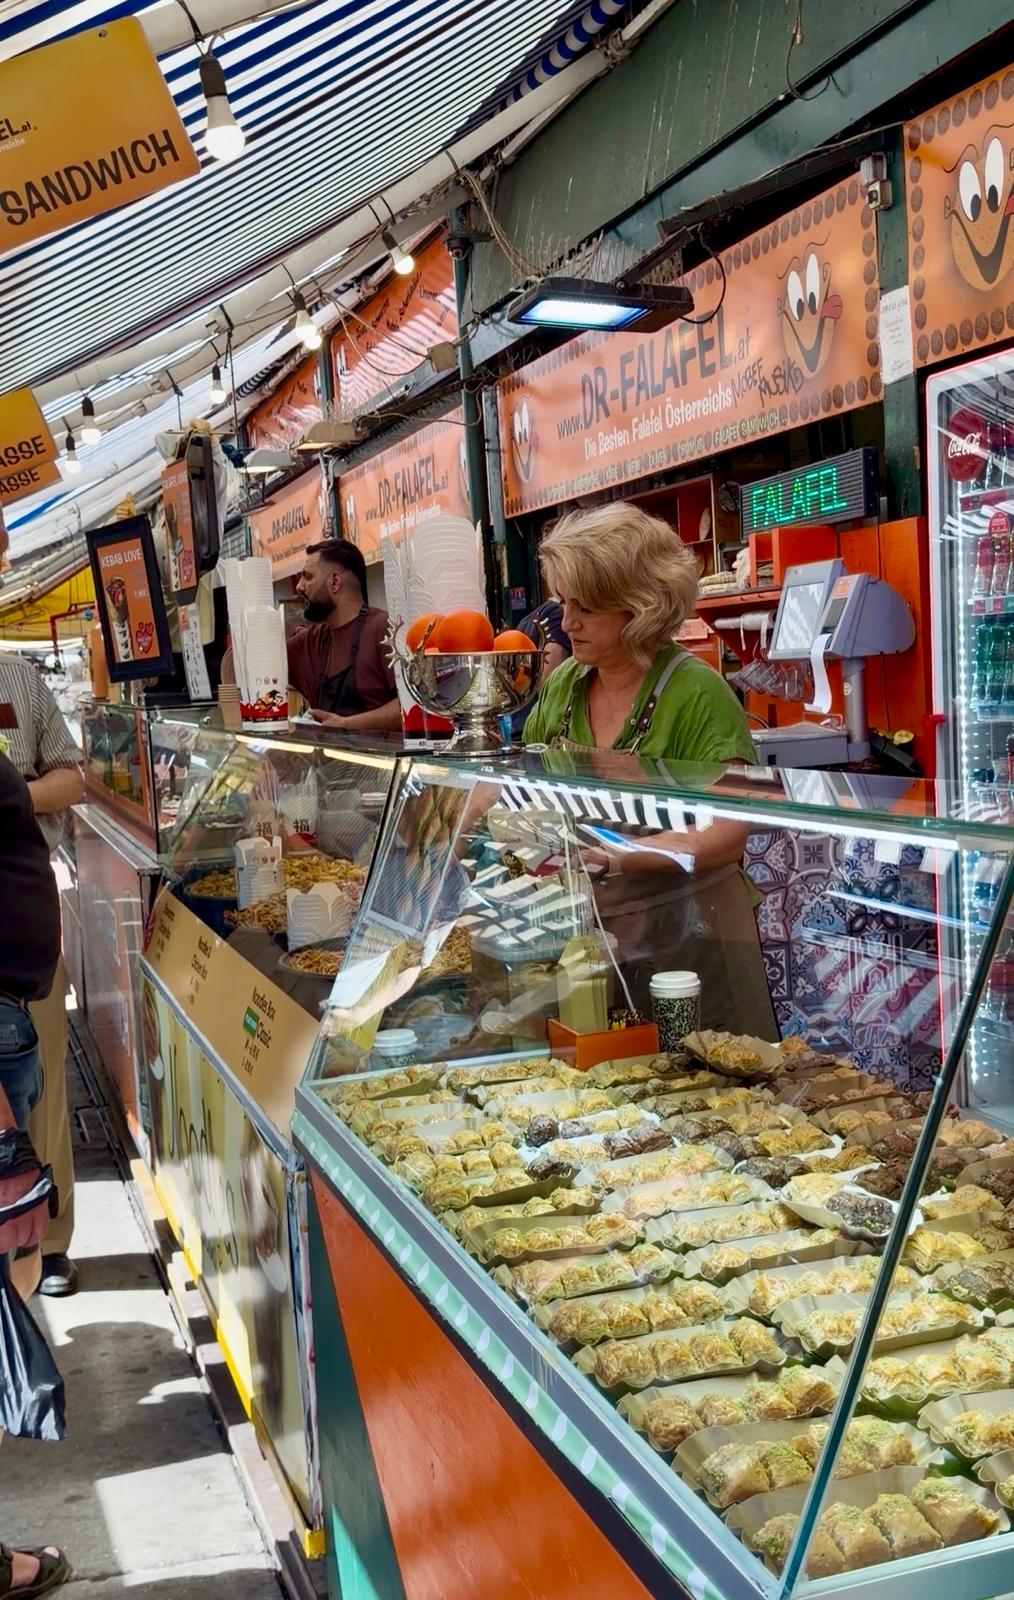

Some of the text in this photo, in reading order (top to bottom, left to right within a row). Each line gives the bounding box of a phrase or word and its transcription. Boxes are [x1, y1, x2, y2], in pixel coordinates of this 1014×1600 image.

[0, 129, 180, 226] SANDWICH
[585, 381, 732, 460] Die Besten Falafel Österreichs
[741, 409, 780, 436] SANDWICH
[752, 464, 848, 528] FALAFEL
[100, 548, 142, 569] KEBAB LOVE
